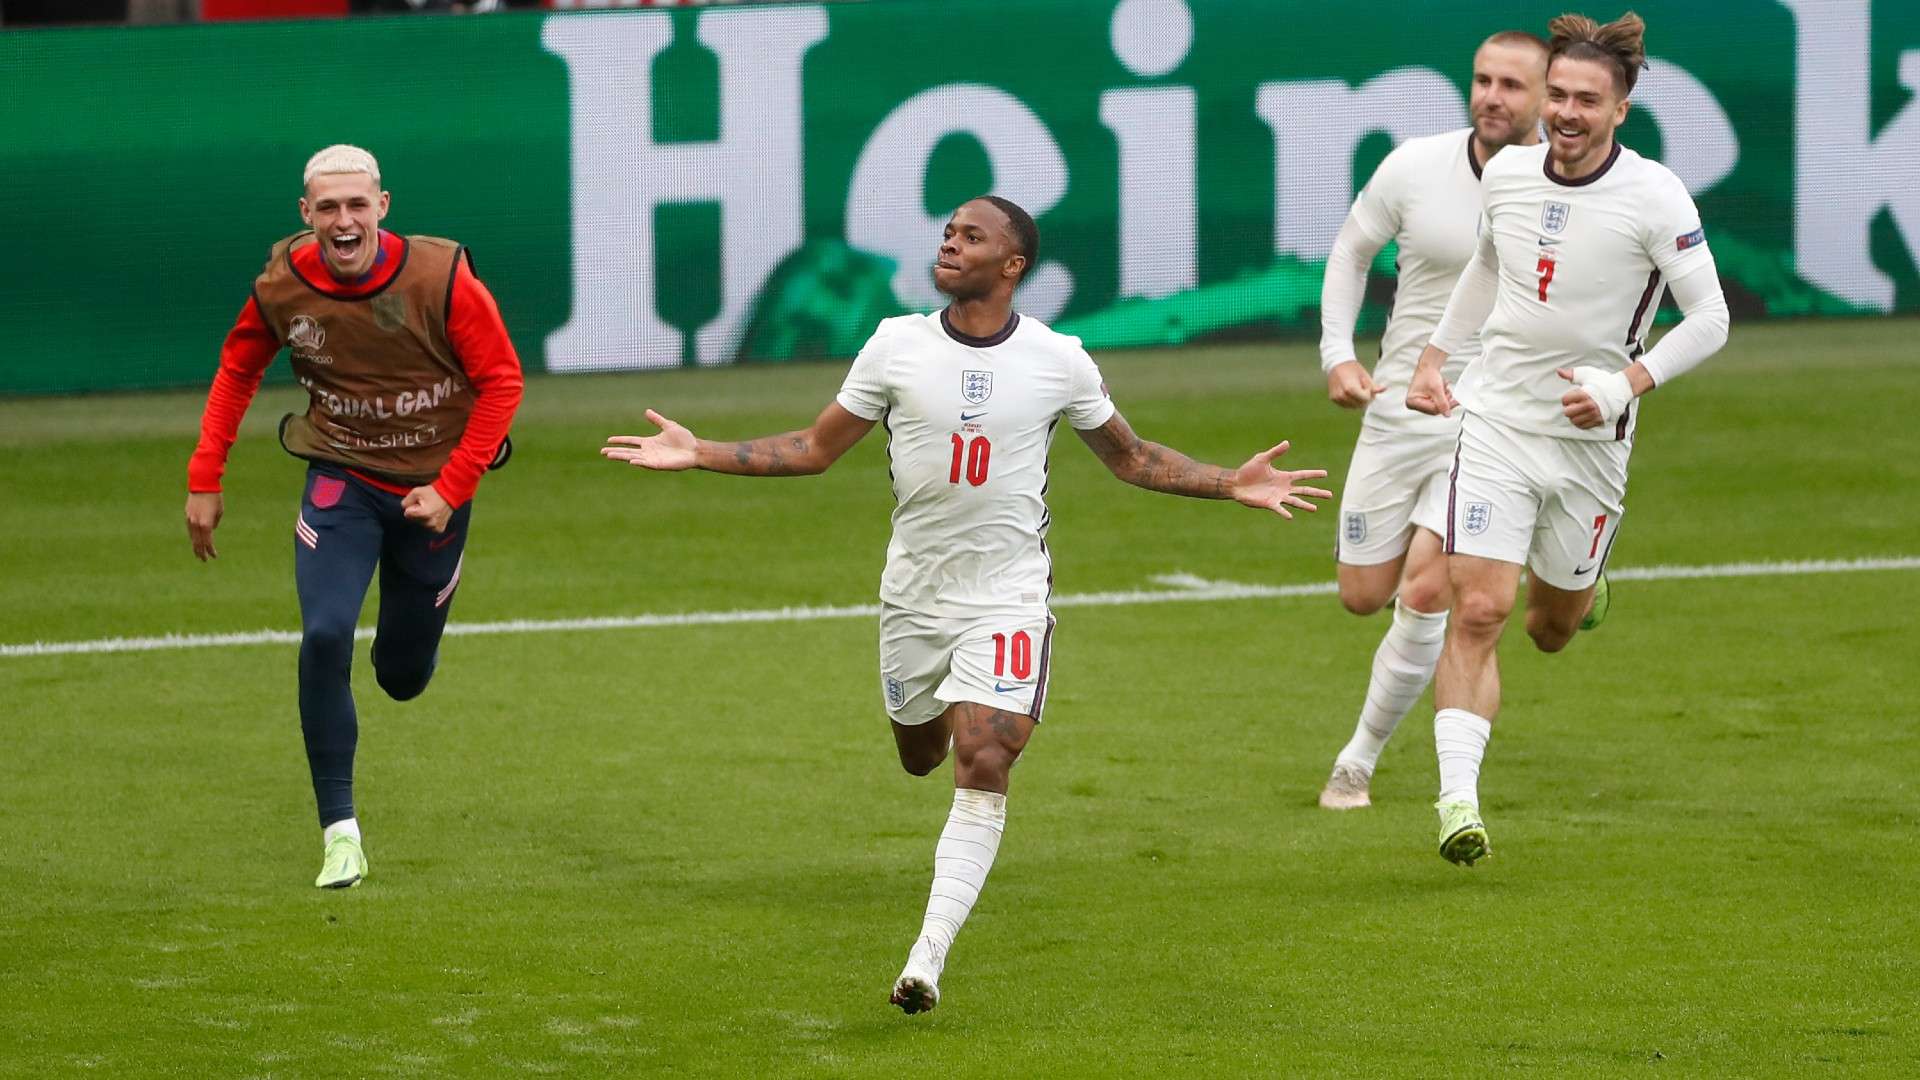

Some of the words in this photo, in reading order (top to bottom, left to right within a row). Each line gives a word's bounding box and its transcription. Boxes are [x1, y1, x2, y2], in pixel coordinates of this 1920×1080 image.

[1536, 258, 1556, 303] 7
[949, 432, 991, 487] 10
[1589, 514, 1607, 560] 7
[992, 630, 1031, 680] 10
